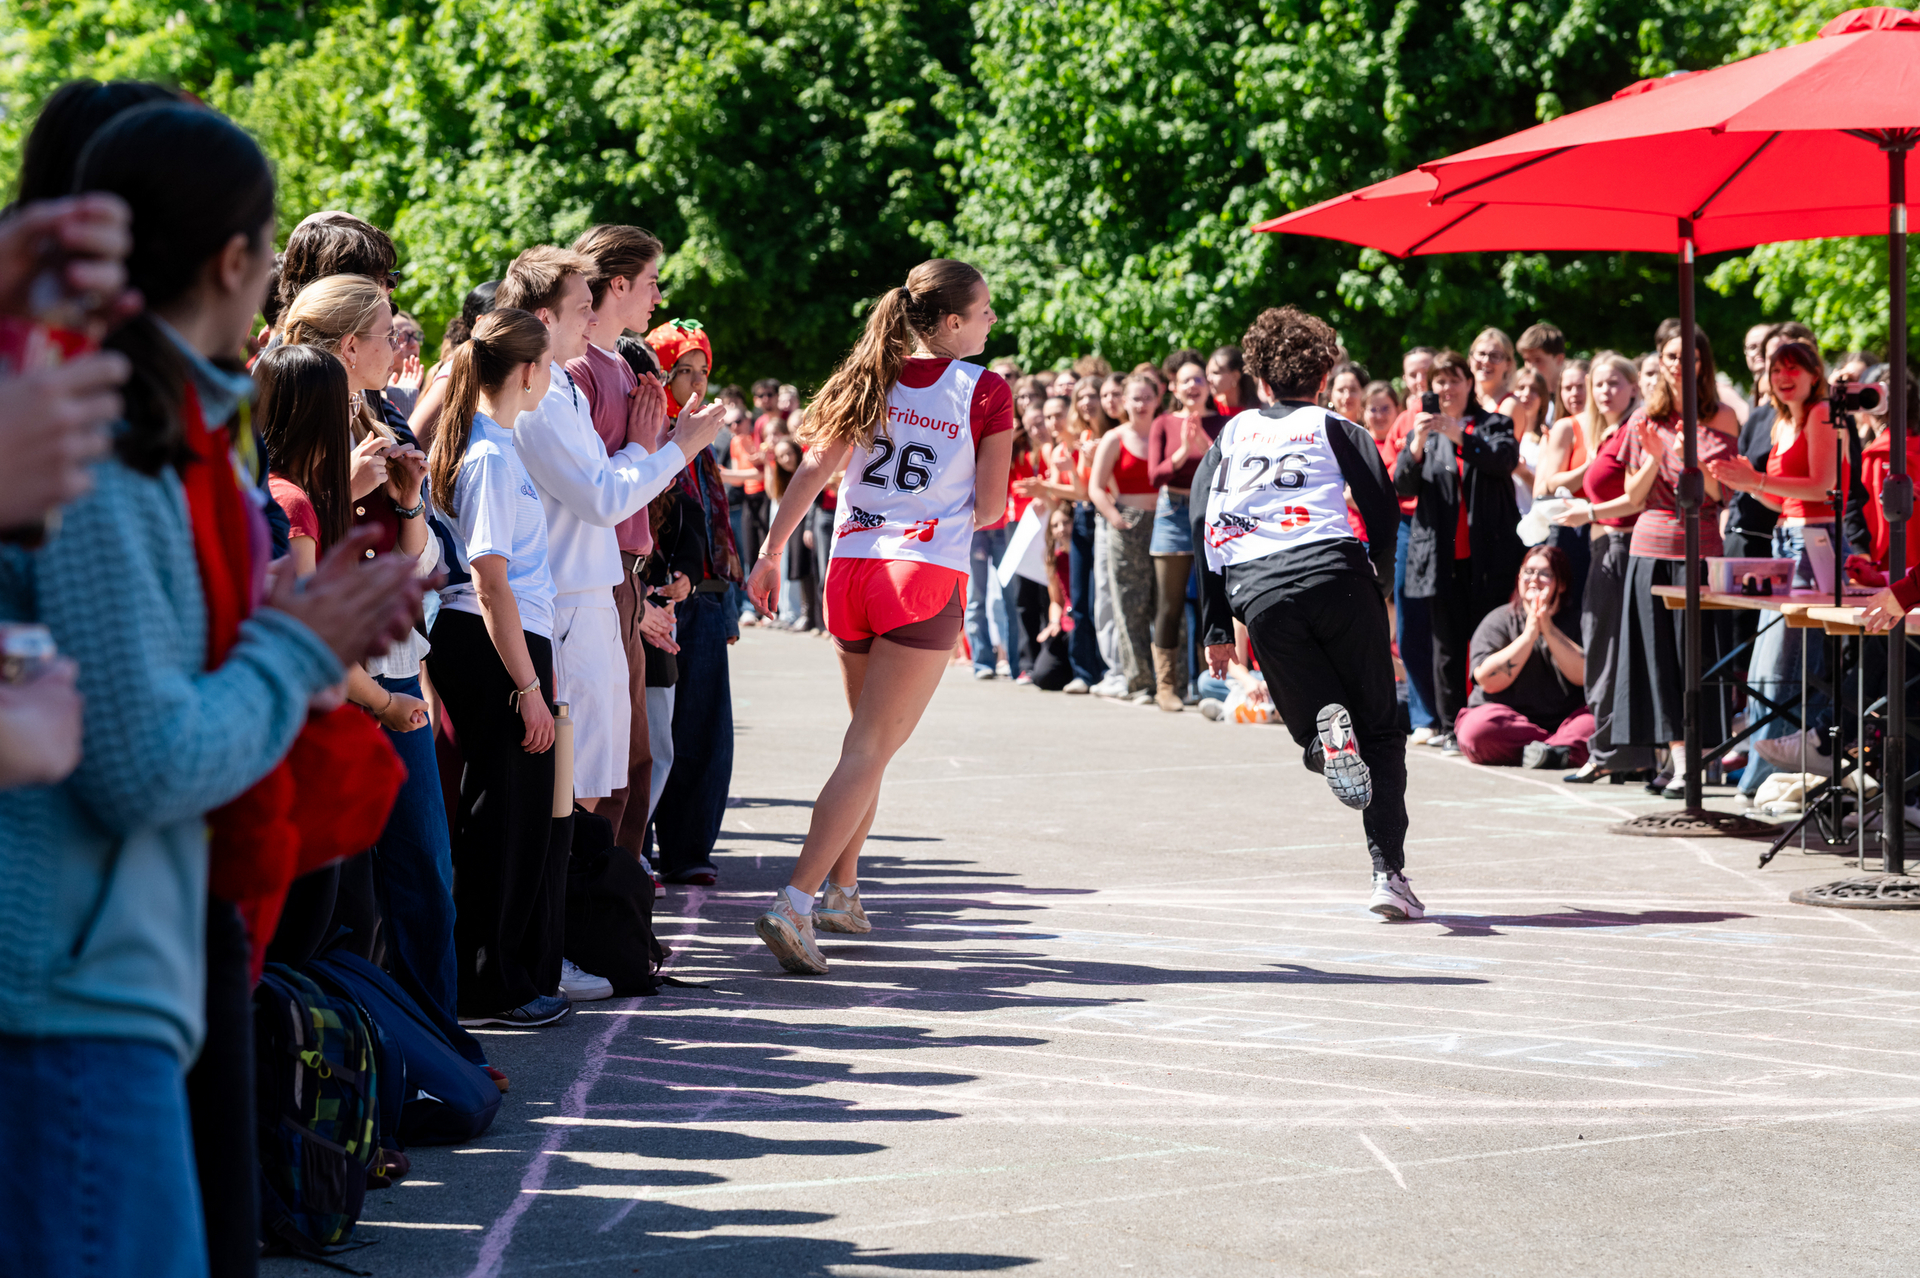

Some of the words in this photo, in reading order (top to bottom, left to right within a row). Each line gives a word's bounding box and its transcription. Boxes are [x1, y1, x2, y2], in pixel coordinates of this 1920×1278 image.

[887, 407, 960, 439] Fribourg
[860, 436, 937, 494] 26
[1212, 453, 1311, 494] 126
[782, 906, 804, 933] HOKA
